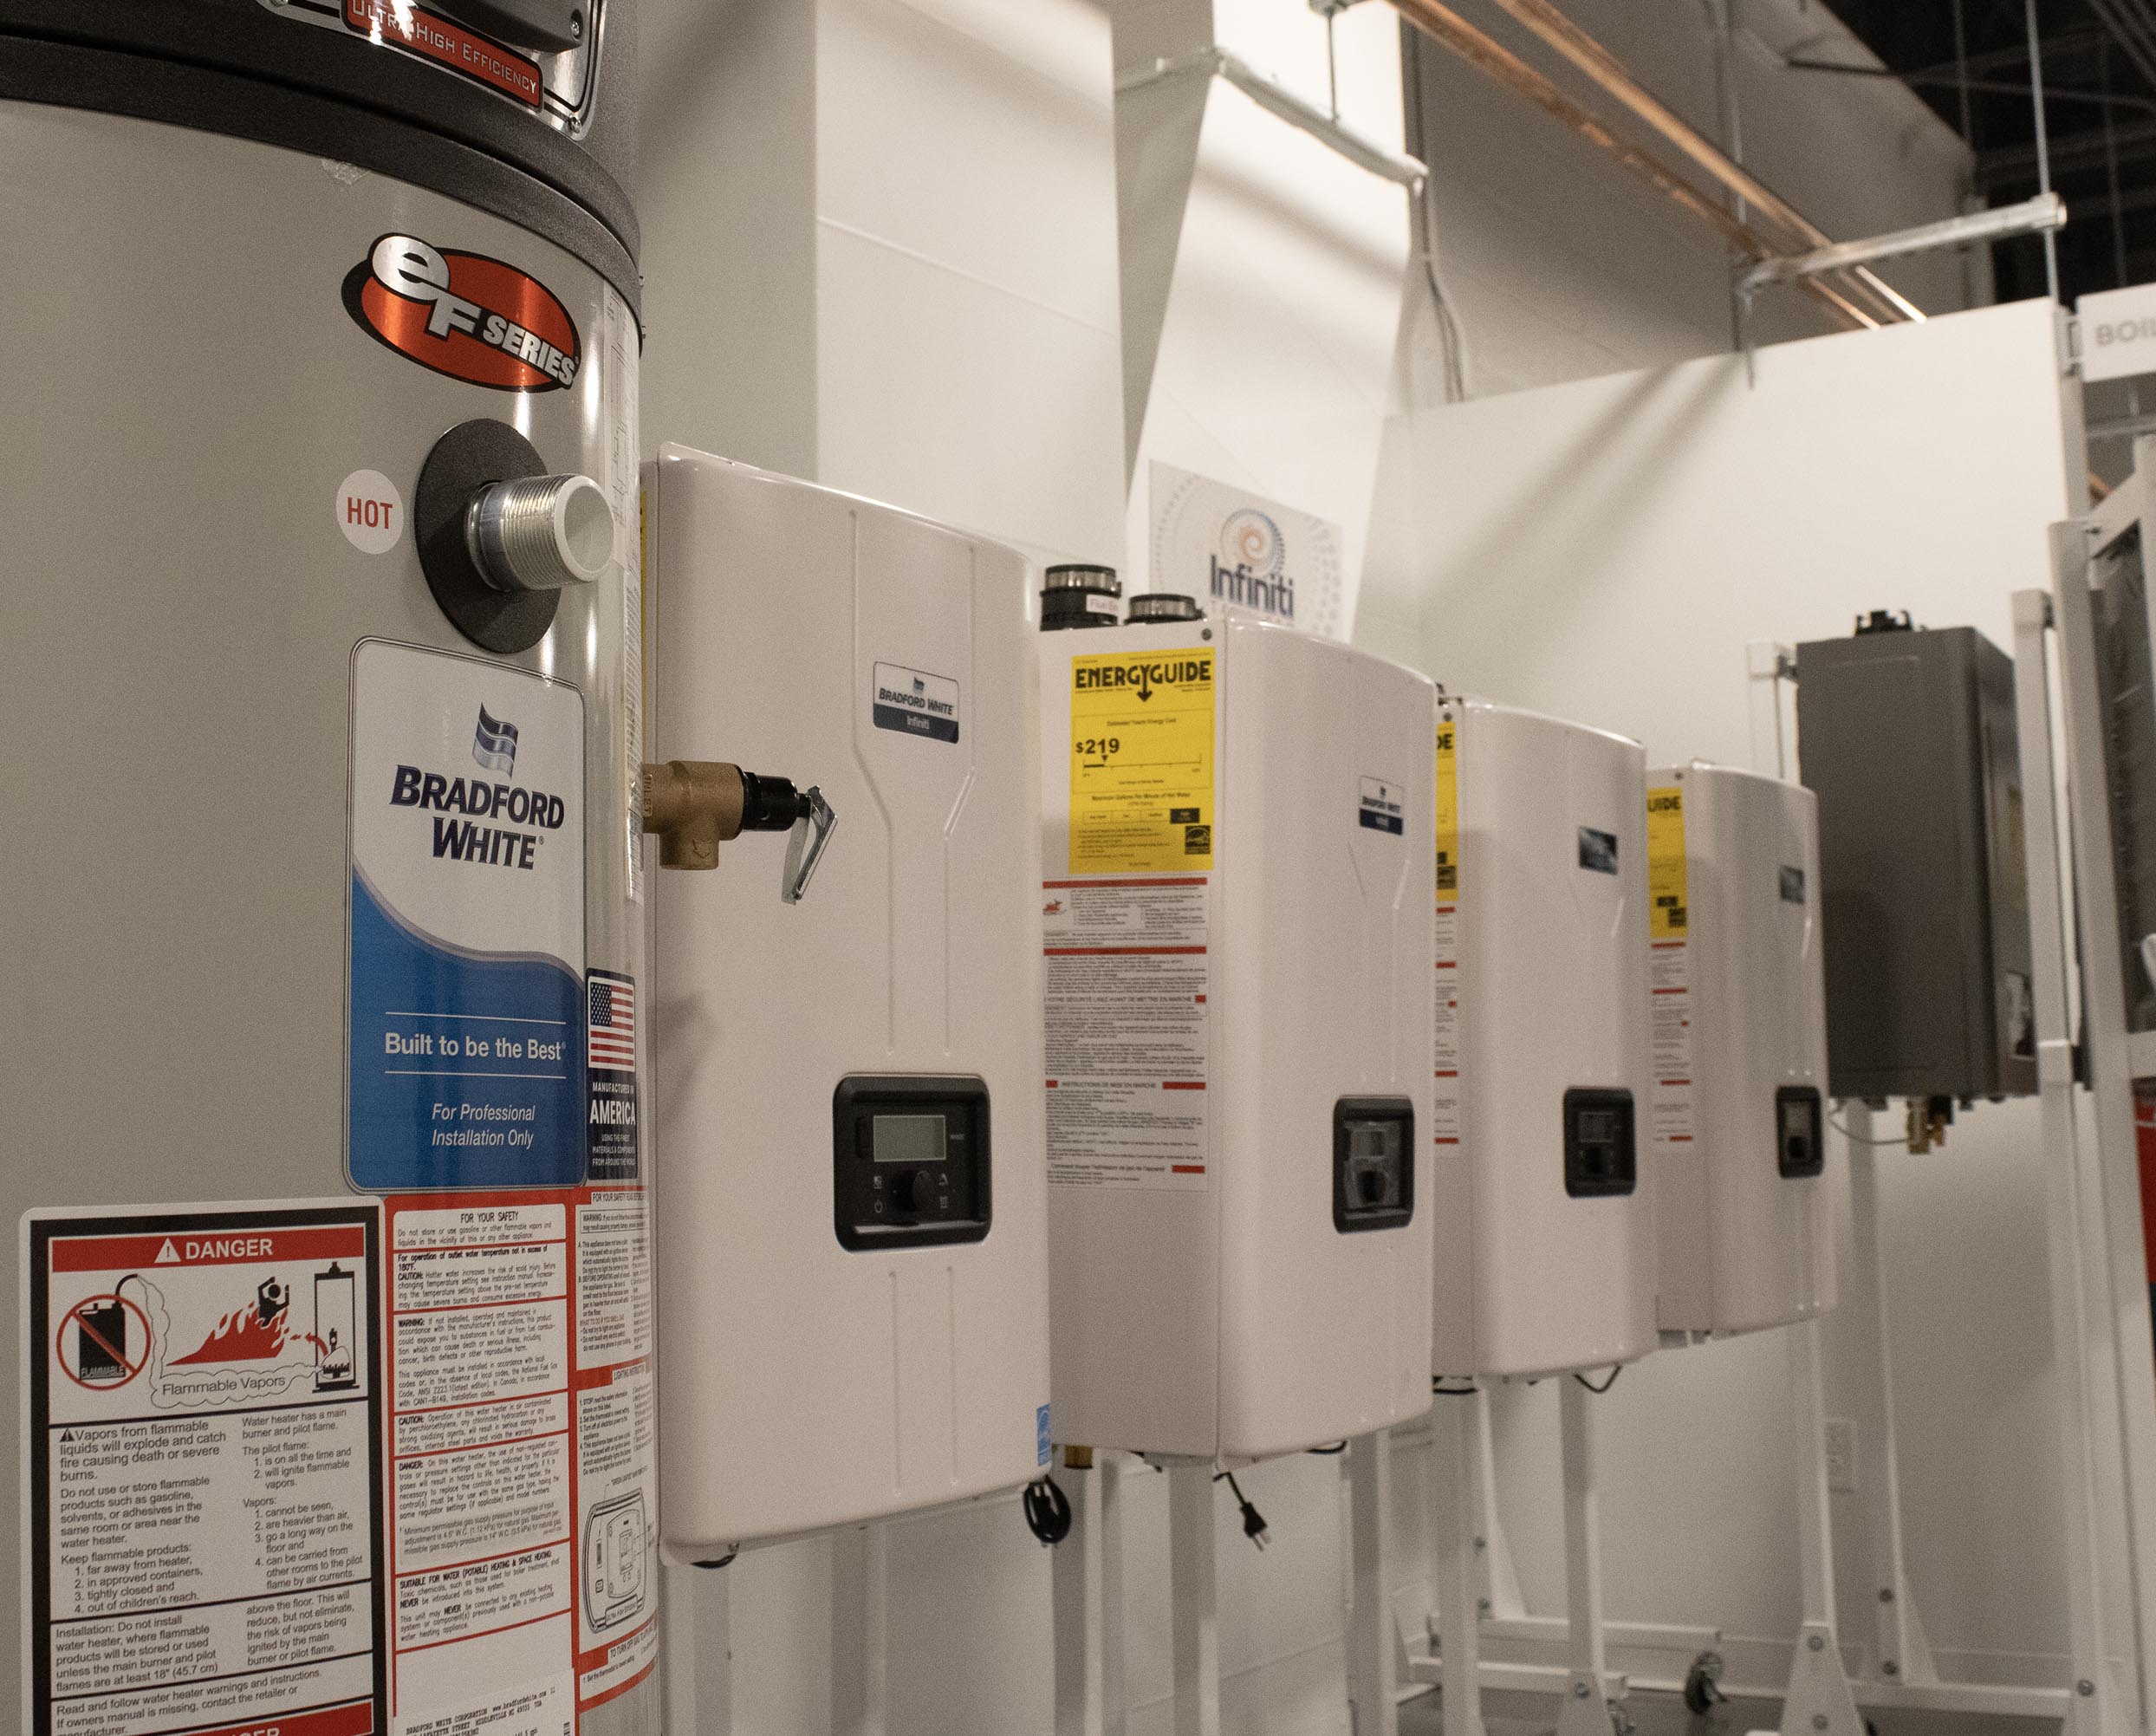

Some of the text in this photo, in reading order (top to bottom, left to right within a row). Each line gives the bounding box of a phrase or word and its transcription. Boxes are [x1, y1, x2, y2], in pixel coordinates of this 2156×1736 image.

[352, 0, 536, 94] ULTR HIGH EFFICIENCY
[483, 314, 576, 386] SERIES
[347, 497, 393, 530] HOT
[1211, 554, 1294, 620] Infiniti
[1075, 660, 1211, 691] ENERGYGUIDE
[879, 687, 953, 716] BRADFORD WHITE
[1075, 738, 1120, 754] $219
[389, 764, 565, 829] BRADFORD
[432, 816, 536, 870] WHITE
[385, 1031, 562, 1061] Built to be the Best
[593, 1082, 629, 1094] MANUFACTURED
[432, 1102, 536, 1122] For Professional
[589, 1099, 636, 1125] AMERICA
[432, 1129, 534, 1149] Installation Only
[593, 1193, 601, 1202] FOR
[602, 1193, 614, 1202] YOUR
[461, 1211, 519, 1223] FOR YOUR SAFETY
[185, 1238, 273, 1261] DANGER
[163, 1376, 286, 1395] Flammable Vapors
[75, 1421, 209, 1442] Vapors from flammable
[60, 1432, 226, 1457] liquids will explode and catch
[60, 1459, 79, 1469] fire
[82, 1454, 128, 1466] causing
[132, 1450, 165, 1462] death
[182, 1448, 219, 1458] severe
[61, 1555, 88, 1564] Keep
[91, 1548, 143, 1562] flammable
[75, 1567, 84, 1576] 1.
[88, 1566, 100, 1575] far
[104, 1564, 130, 1574] away
[134, 1561, 156, 1570] from
[399, 1577, 425, 1589] SUITABLE
[443, 1571, 459, 1582] WATER
[490, 1561, 510, 1570] HEATING
[518, 1555, 532, 1564] SPACE
[75, 1580, 84, 1589] 2.
[88, 1578, 96, 1588] in
[100, 1572, 146, 1588] approved
[75, 1583, 174, 1602] 3. tightly closed and
[75, 1591, 198, 1614] 4. out of children's reach.
[400, 1598, 419, 1609] NEVER
[445, 1603, 461, 1614] NEVER
[56, 1616, 182, 1638] Installation: Do not install
[56, 1642, 85, 1652] water
[127, 1634, 156, 1644] where
[159, 1626, 210, 1640] flammable
[56, 1653, 101, 1668] products
[104, 1648, 120, 1659] will
[123, 1648, 135, 1657] be
[139, 1642, 169, 1655] stored
[185, 1638, 209, 1649] used
[56, 1651, 216, 1678] unless the main burner and pilot
[56, 1681, 91, 1692] flames
[114, 1676, 123, 1685] at
[127, 1673, 151, 1683] least
[200, 1663, 218, 1674] cm)
[57, 1703, 85, 1715] Read
[88, 1700, 107, 1712] and
[111, 1697, 140, 1708] follow
[142, 1694, 171, 1704] water
[173, 1690, 203, 1700] heater
[206, 1683, 248, 1695] warnings
[250, 1677, 268, 1688] and
[67, 1716, 104, 1727] owners
[107, 1708, 145, 1722] manual
[148, 1707, 156, 1716] is
[202, 1695, 236, 1709] contact
[238, 1693, 252, 1703] the
[256, 1687, 286, 1700] retailer
[406, 1722, 433, 1735] BRADFORD
[436, 1718, 452, 1728] WHITE
